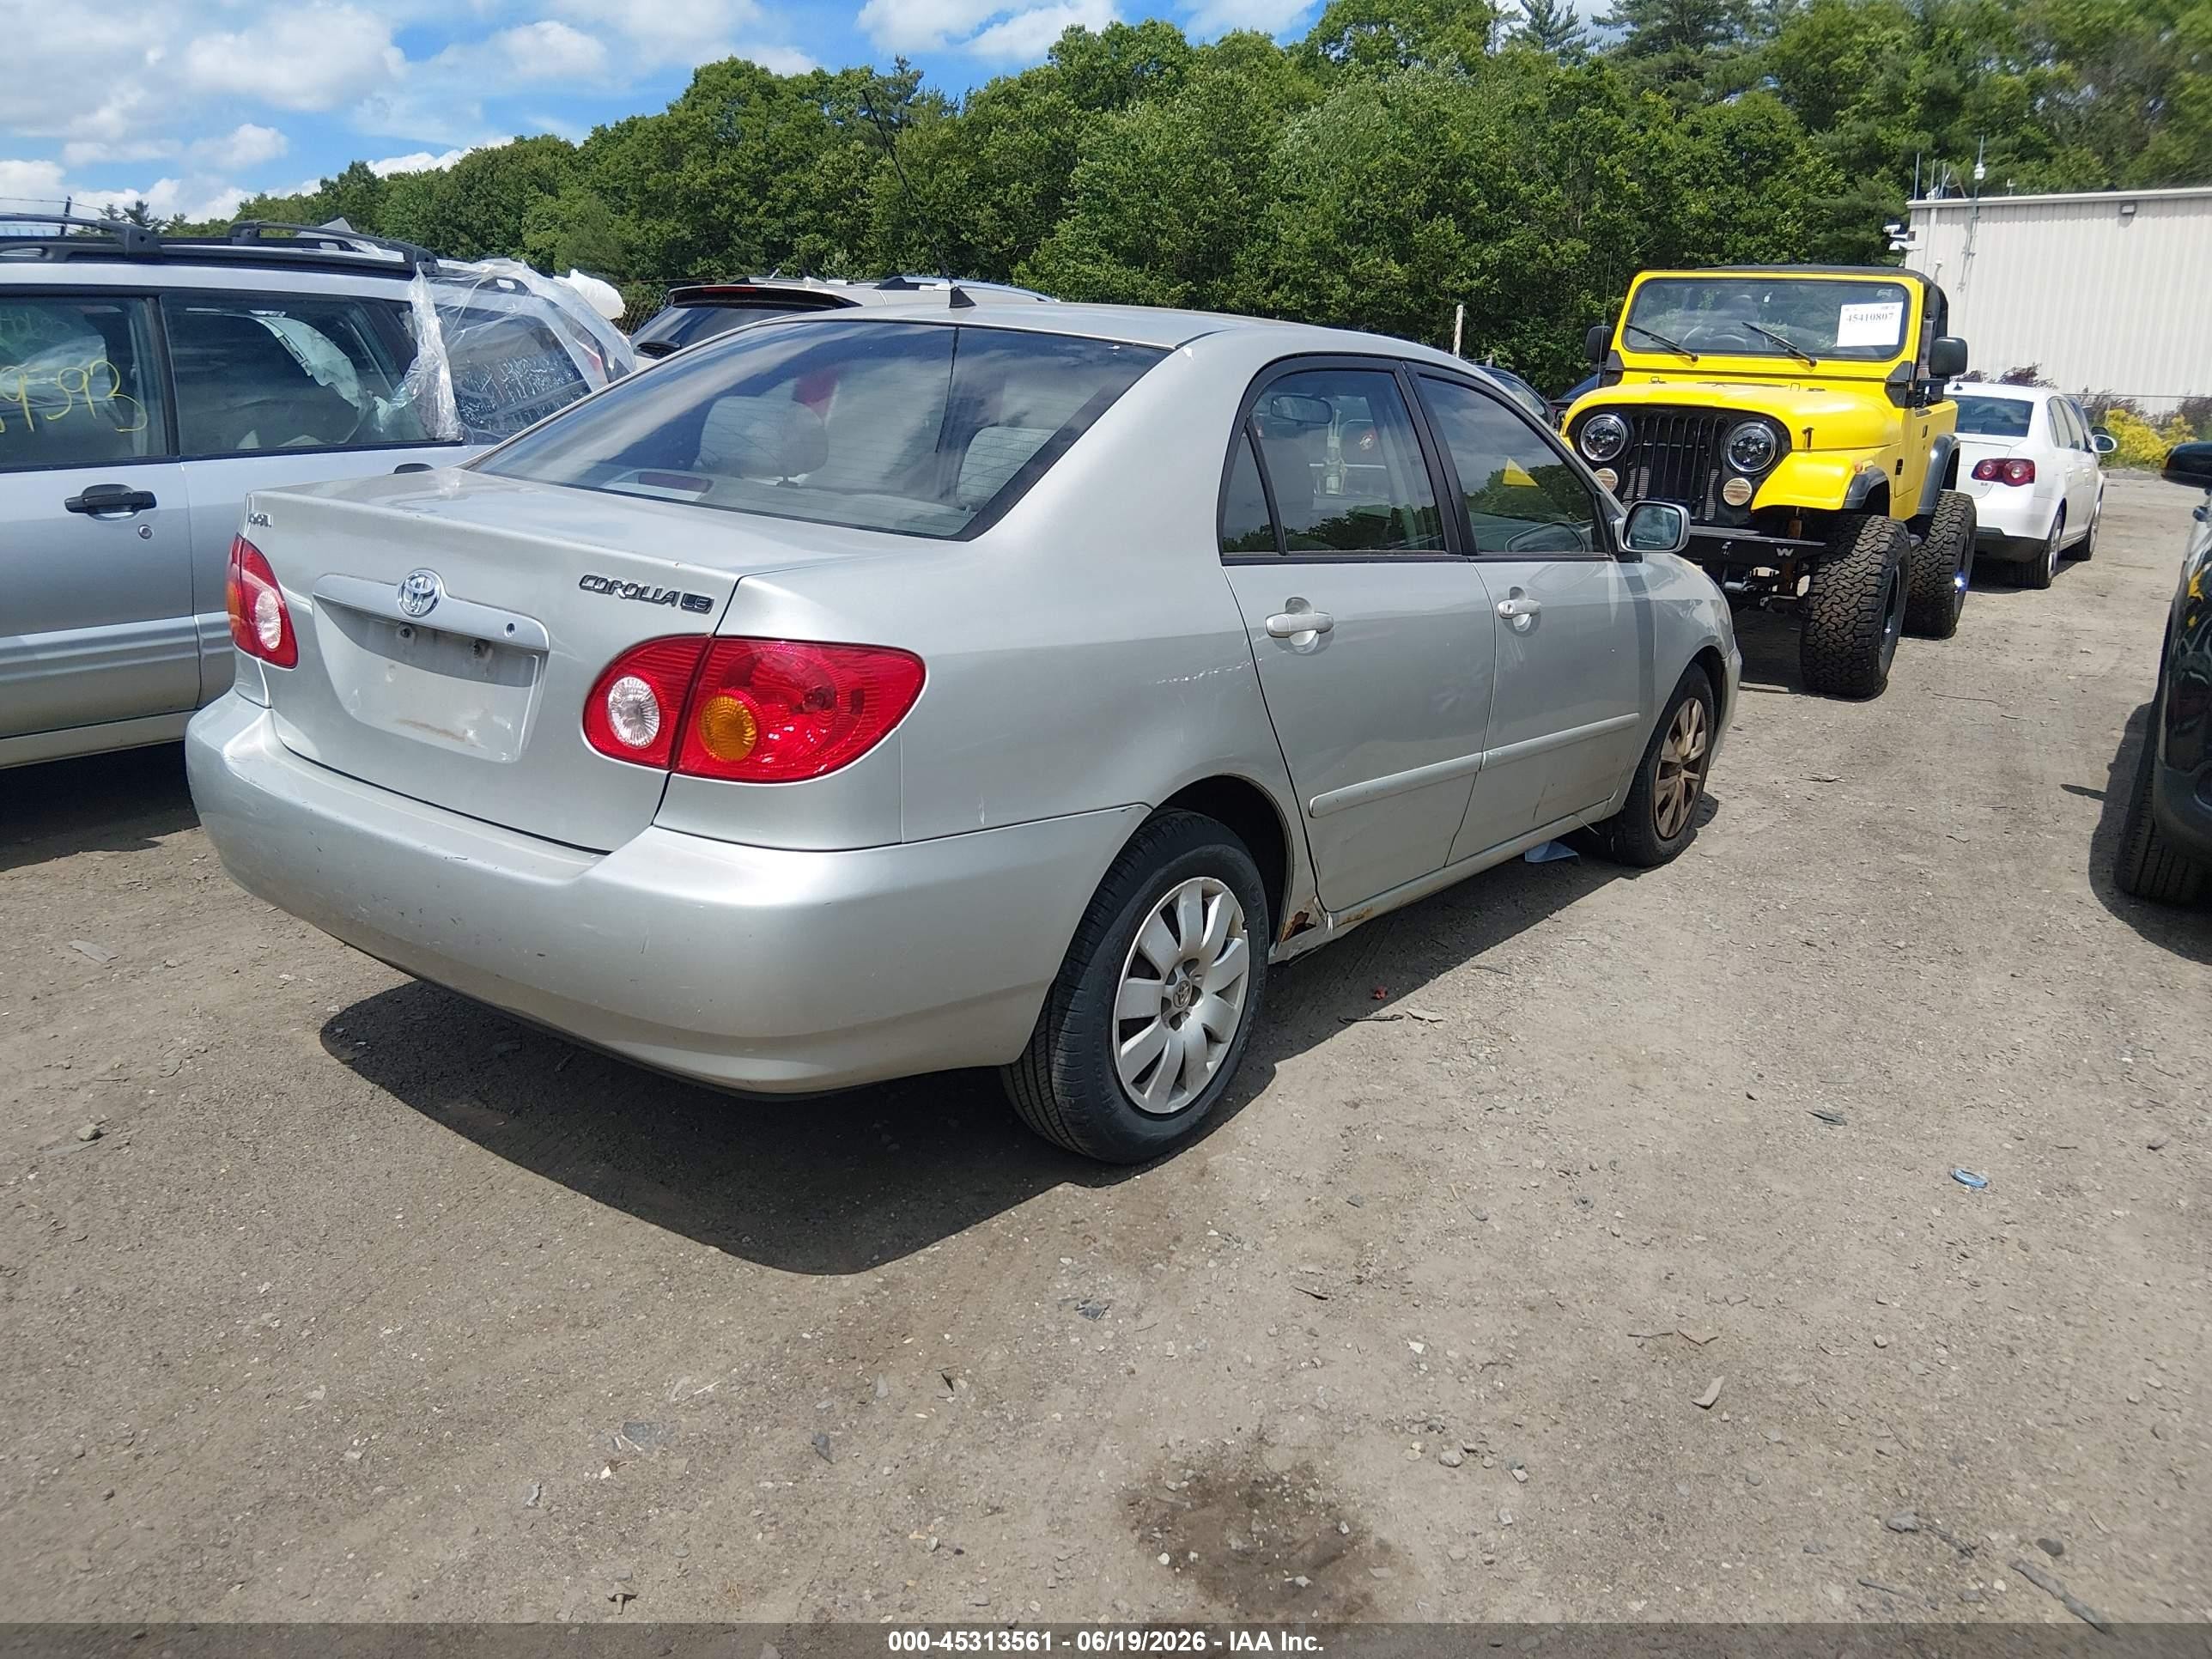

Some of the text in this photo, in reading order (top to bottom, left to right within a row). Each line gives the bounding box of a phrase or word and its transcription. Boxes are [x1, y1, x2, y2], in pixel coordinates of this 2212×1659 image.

[0, 359, 148, 433] 9593
[579, 574, 714, 615] COROLLA LE
